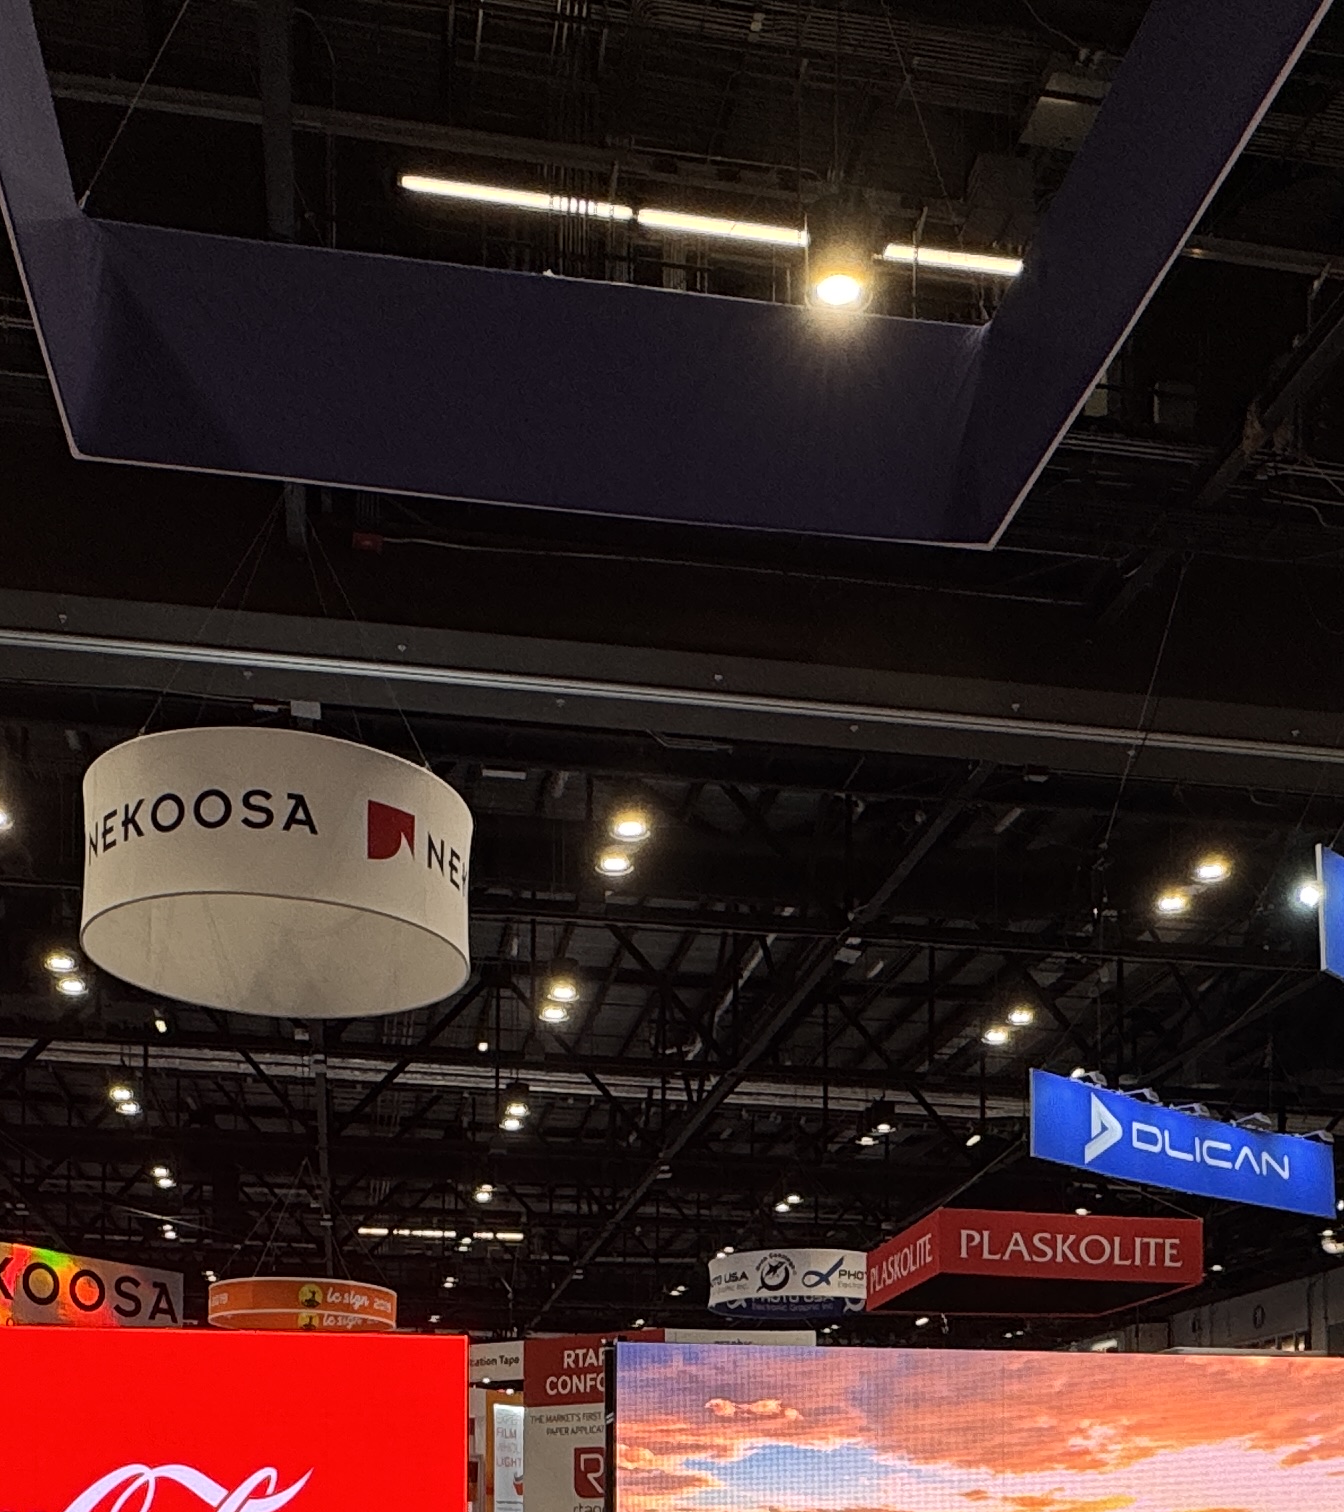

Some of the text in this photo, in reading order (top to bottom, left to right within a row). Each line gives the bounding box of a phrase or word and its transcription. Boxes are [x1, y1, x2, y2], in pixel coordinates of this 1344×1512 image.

[88, 788, 318, 866] NEKOOSA
[1131, 1120, 1290, 1180] DLICAN
[869, 1232, 933, 1295] PLASKOLITE
[959, 1229, 1184, 1268] PLASKOLITE
[838, 1269, 867, 1281] PHO
[499, 1354, 520, 1368] Tape
